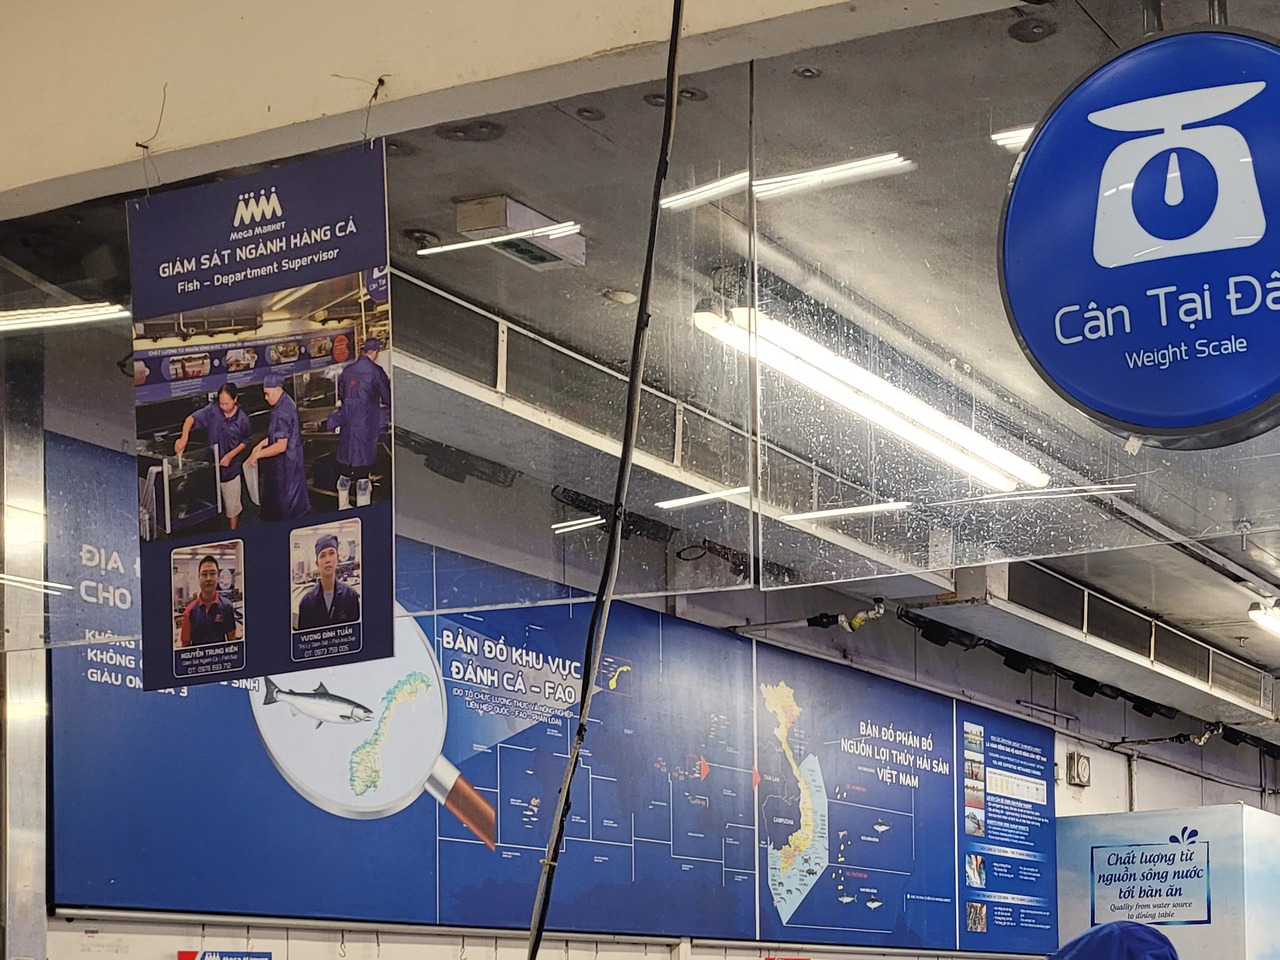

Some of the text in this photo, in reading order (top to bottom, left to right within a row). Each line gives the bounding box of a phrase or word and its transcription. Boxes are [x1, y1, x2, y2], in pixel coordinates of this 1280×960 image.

[159, 216, 357, 278] GIÁM SÁT NGÀNH HÀNG CÁ
[177, 247, 340, 294] Fish Department Supervisor
[1055, 301, 1131, 345] Cân
[1146, 284, 1211, 330] Tại
[1125, 335, 1248, 370] Weight Scale
[80, 544, 125, 576] ĐỊA
[80, 580, 132, 610] CHO
[88, 649, 135, 668] KHÔNG
[205, 648, 224, 656] TRUNG
[442, 628, 582, 680] BẢN ĐỒ KHU VỰC
[88, 668, 121, 685] GIÀU
[450, 660, 576, 704] ĐÁNH CÁ FAO
[515, 710, 528, 720] FAO
[860, 719, 879, 738] BẢN
[896, 730, 920, 748] PHÂN
[921, 733, 933, 752] BỐ
[874, 746, 889, 764] LỢI
[891, 749, 915, 767] THỦY
[916, 754, 931, 772] HẢI
[932, 757, 950, 775] SẢN
[876, 765, 919, 788] VIỆT NAM
[1107, 849, 1195, 866] Chất lượng từ
[1098, 866, 1204, 886] nguồn sông nước
[1118, 884, 1183, 900] tới bàn ăn
[1110, 903, 1134, 913] Quality
[1135, 902, 1151, 912] from
[1135, 912, 1157, 920] dining
[1158, 911, 1175, 919] table
